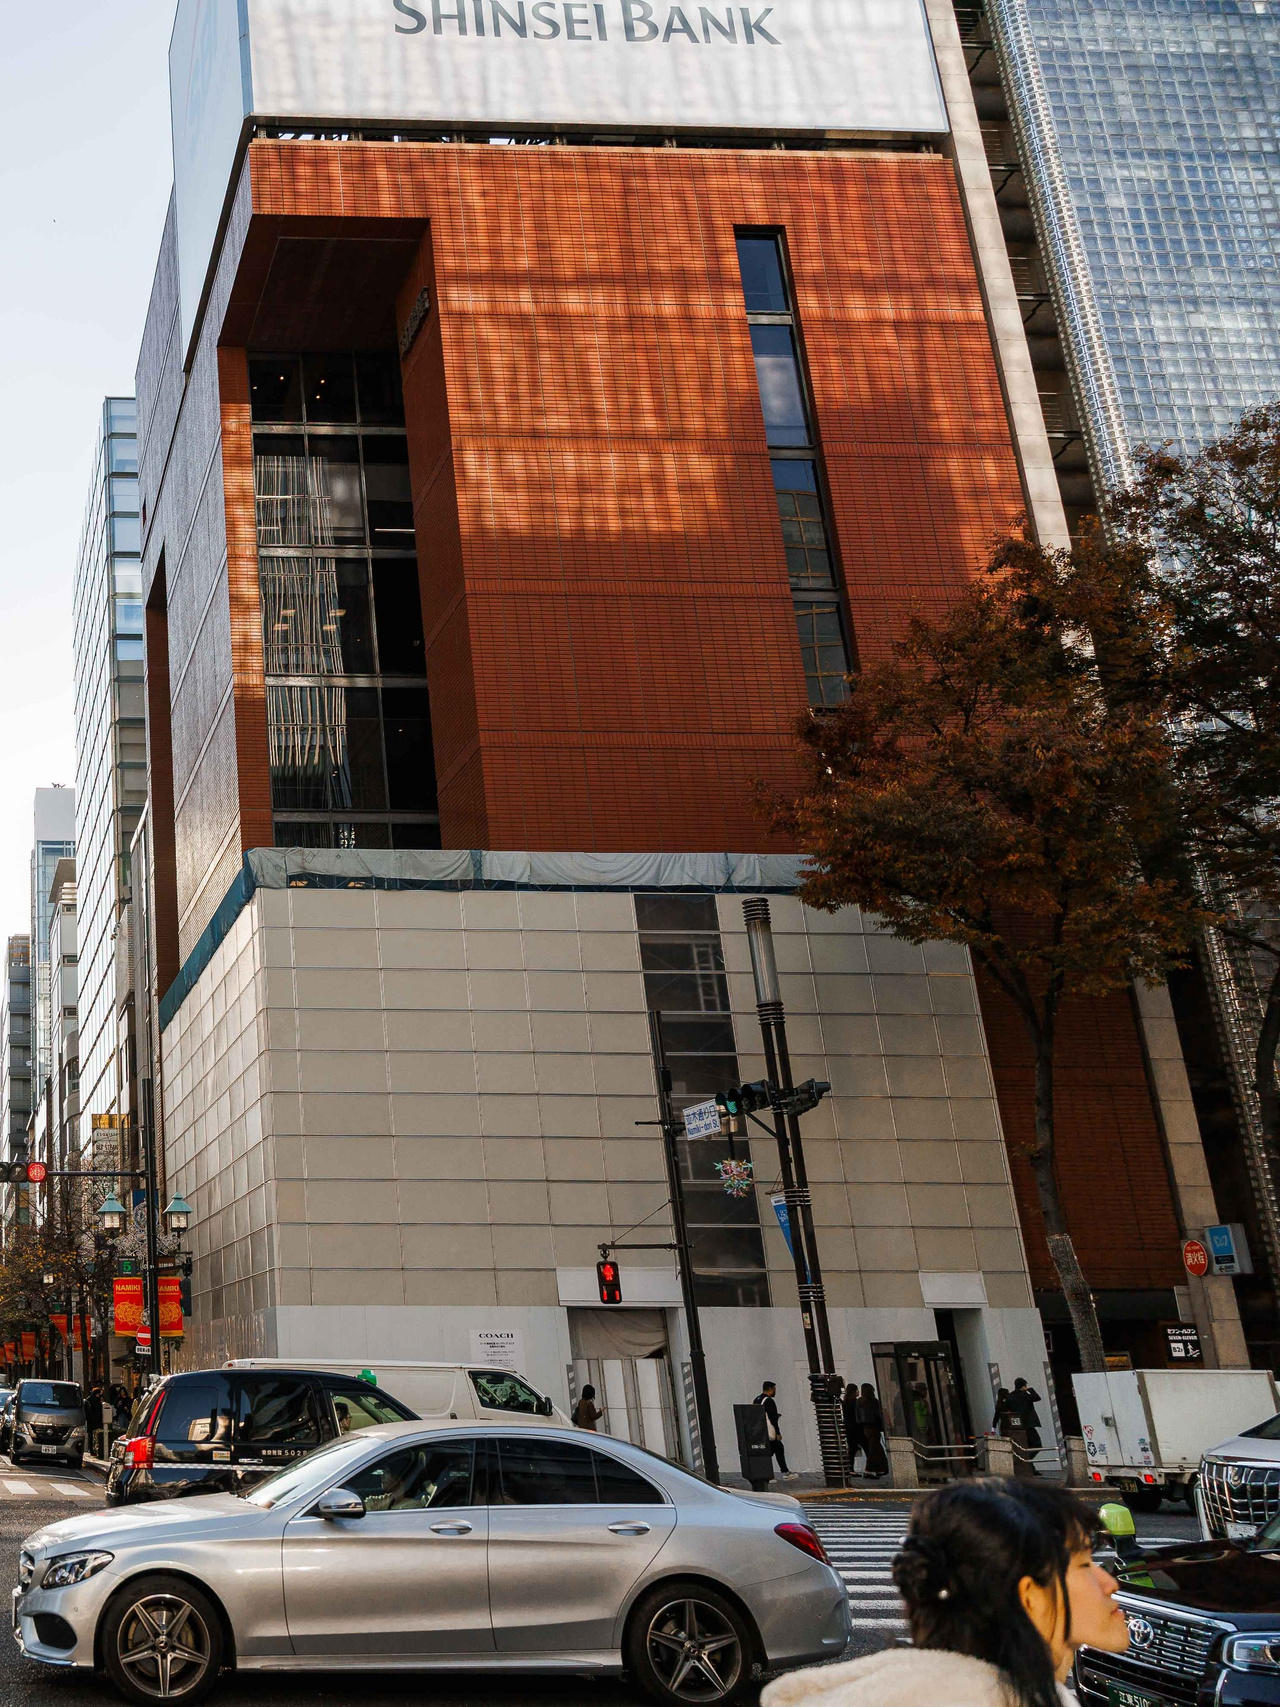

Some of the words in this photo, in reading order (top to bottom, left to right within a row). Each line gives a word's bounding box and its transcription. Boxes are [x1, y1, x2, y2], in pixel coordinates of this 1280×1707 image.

[394, 0, 608, 42] SHINSEI
[623, 0, 782, 45] BANK
[123, 1261, 131, 1272] 5
